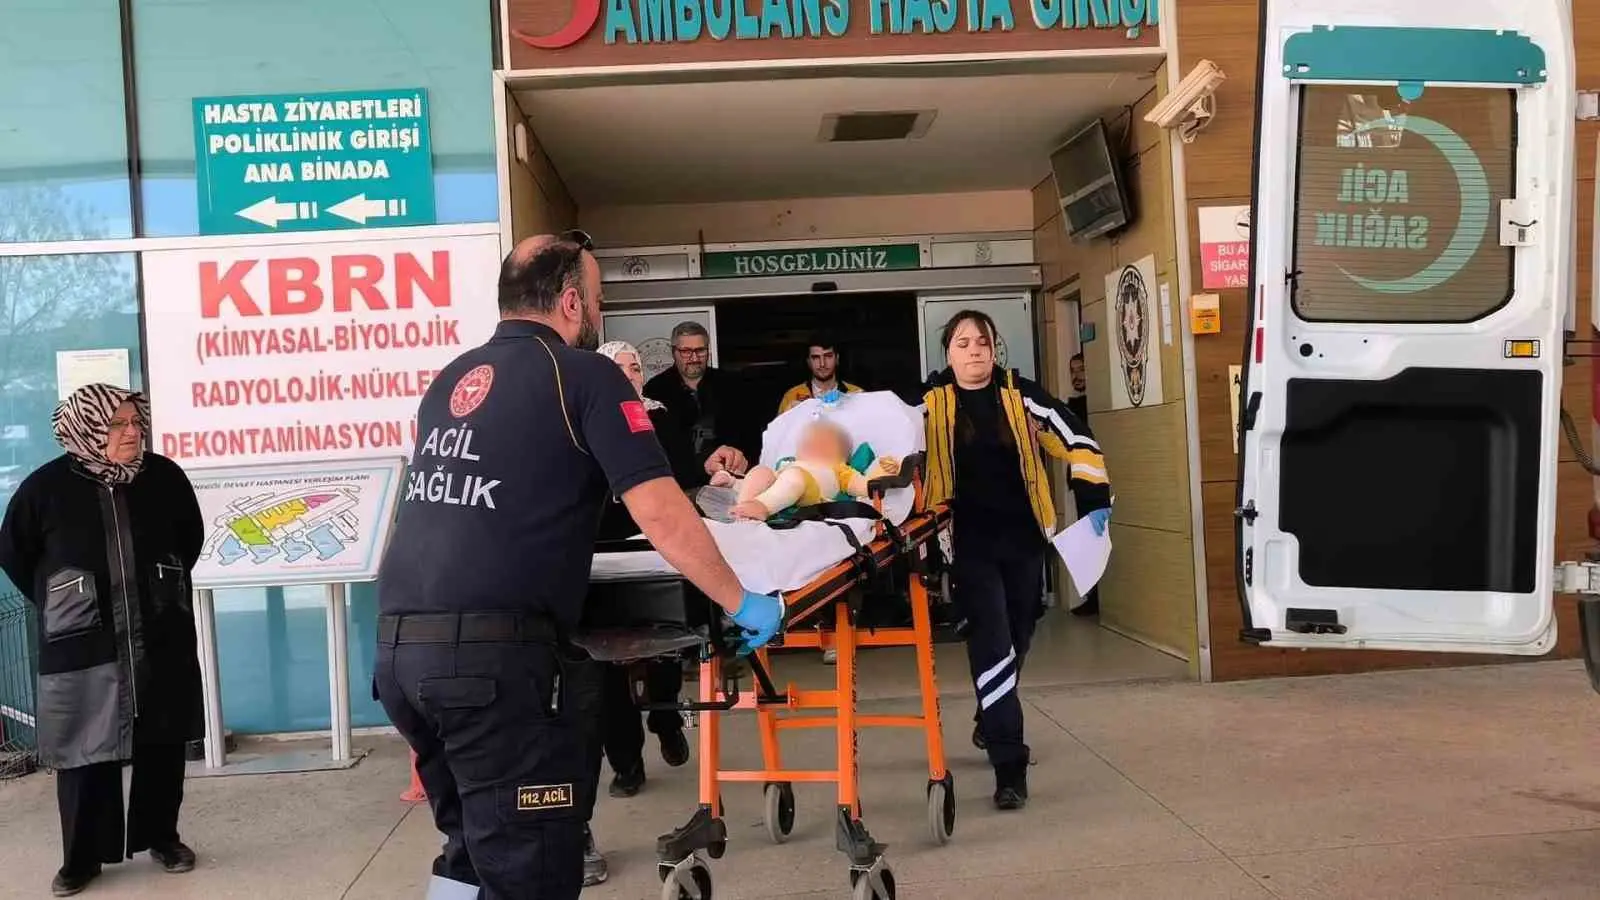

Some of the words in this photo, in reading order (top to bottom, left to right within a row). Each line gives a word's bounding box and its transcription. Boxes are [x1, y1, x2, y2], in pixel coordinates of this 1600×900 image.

[204, 102, 278, 124] HASTA
[284, 93, 422, 122] ZİYARETLERİ
[209, 127, 344, 154] POLİKLİNİK
[350, 121, 420, 153] GİRİŞİ
[243, 163, 295, 183] ANA
[301, 155, 390, 181] BİNADA
[198, 250, 452, 319] KBRN
[196, 313, 461, 365] (KİMYASAL-BİYOLOJİK
[191, 367, 442, 408] RADYOLOJİK-NÜKLE
[162, 419, 402, 459] DEKONTAMİNASYON
[421, 422, 481, 462] ACİL
[405, 464, 502, 510] SAĞLIK
[520, 792, 540, 805] 112
[542, 787, 567, 804] ACİL
